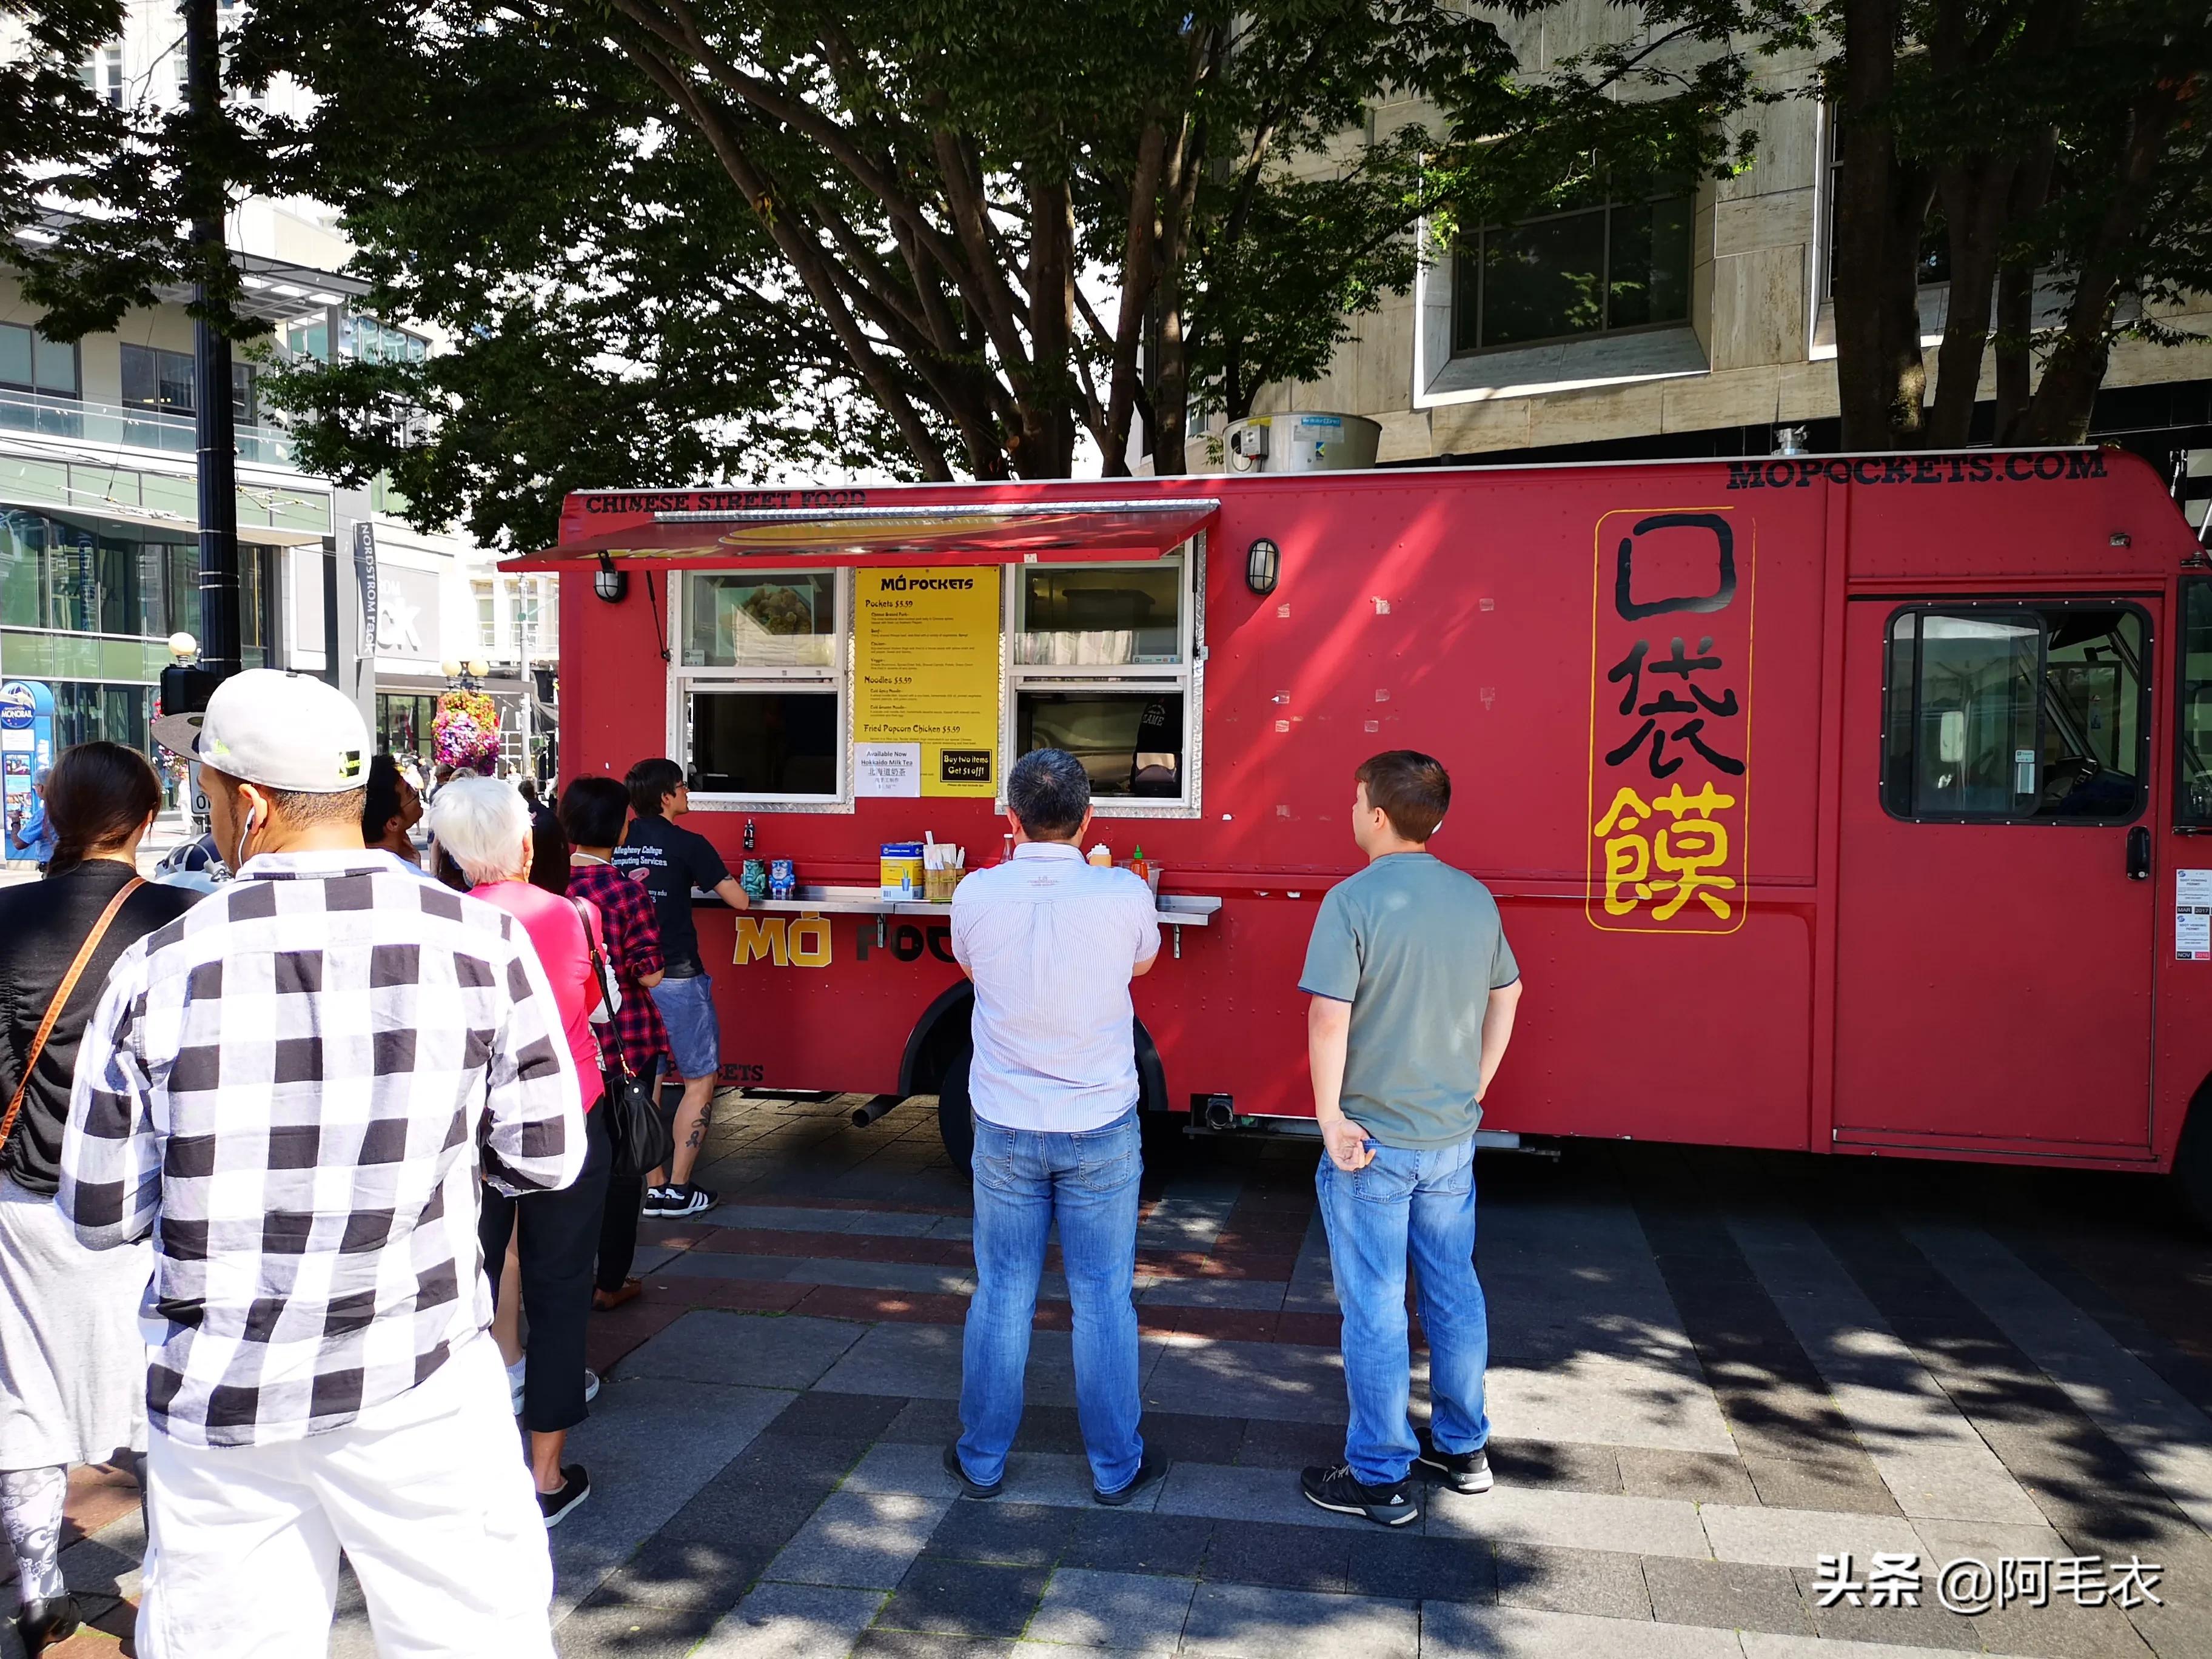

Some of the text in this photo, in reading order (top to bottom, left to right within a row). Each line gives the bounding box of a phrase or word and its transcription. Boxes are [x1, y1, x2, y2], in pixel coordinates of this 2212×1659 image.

[1726, 451, 2108, 489] MOPOCKETS.COM
[586, 489, 867, 514] CHINESE STREET FOOD
[361, 525, 376, 654] NORDSTROM rack
[881, 574, 973, 591] MÓ POCKETS
[865, 675, 892, 684] Noodles
[1595, 513, 1745, 921] 口袋饃
[883, 725, 911, 734] Popcorn
[913, 725, 940, 734] Chicken
[944, 755, 957, 765] Buy
[971, 767, 984, 777] off!
[614, 845, 663, 856] Allegheny College
[611, 856, 668, 866] Computing Services
[733, 911, 832, 968] MÓ
